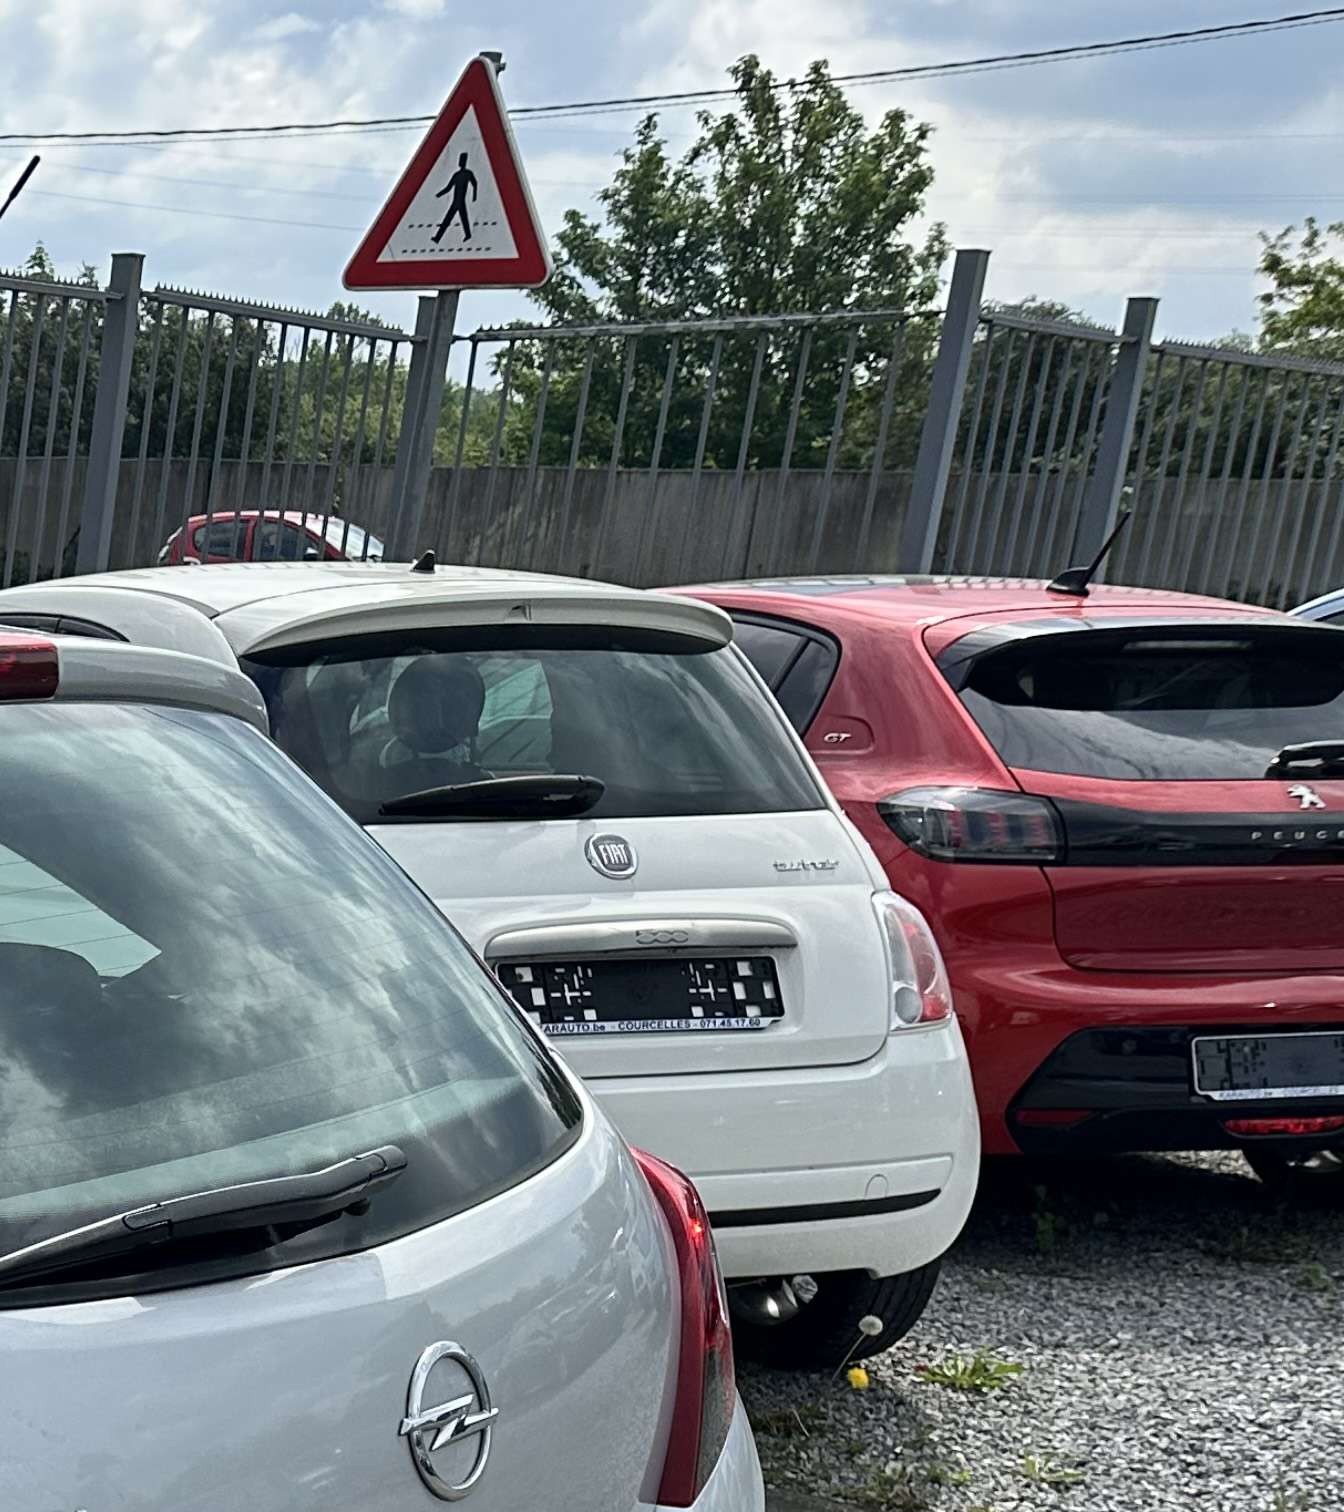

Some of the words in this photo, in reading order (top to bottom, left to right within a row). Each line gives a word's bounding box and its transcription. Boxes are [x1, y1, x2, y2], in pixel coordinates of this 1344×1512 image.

[824, 732, 852, 742] GT
[598, 842, 630, 866] FIAT
[542, 1024, 606, 1035] ARAUTO.be
[618, 1019, 692, 1031] COURCELLES
